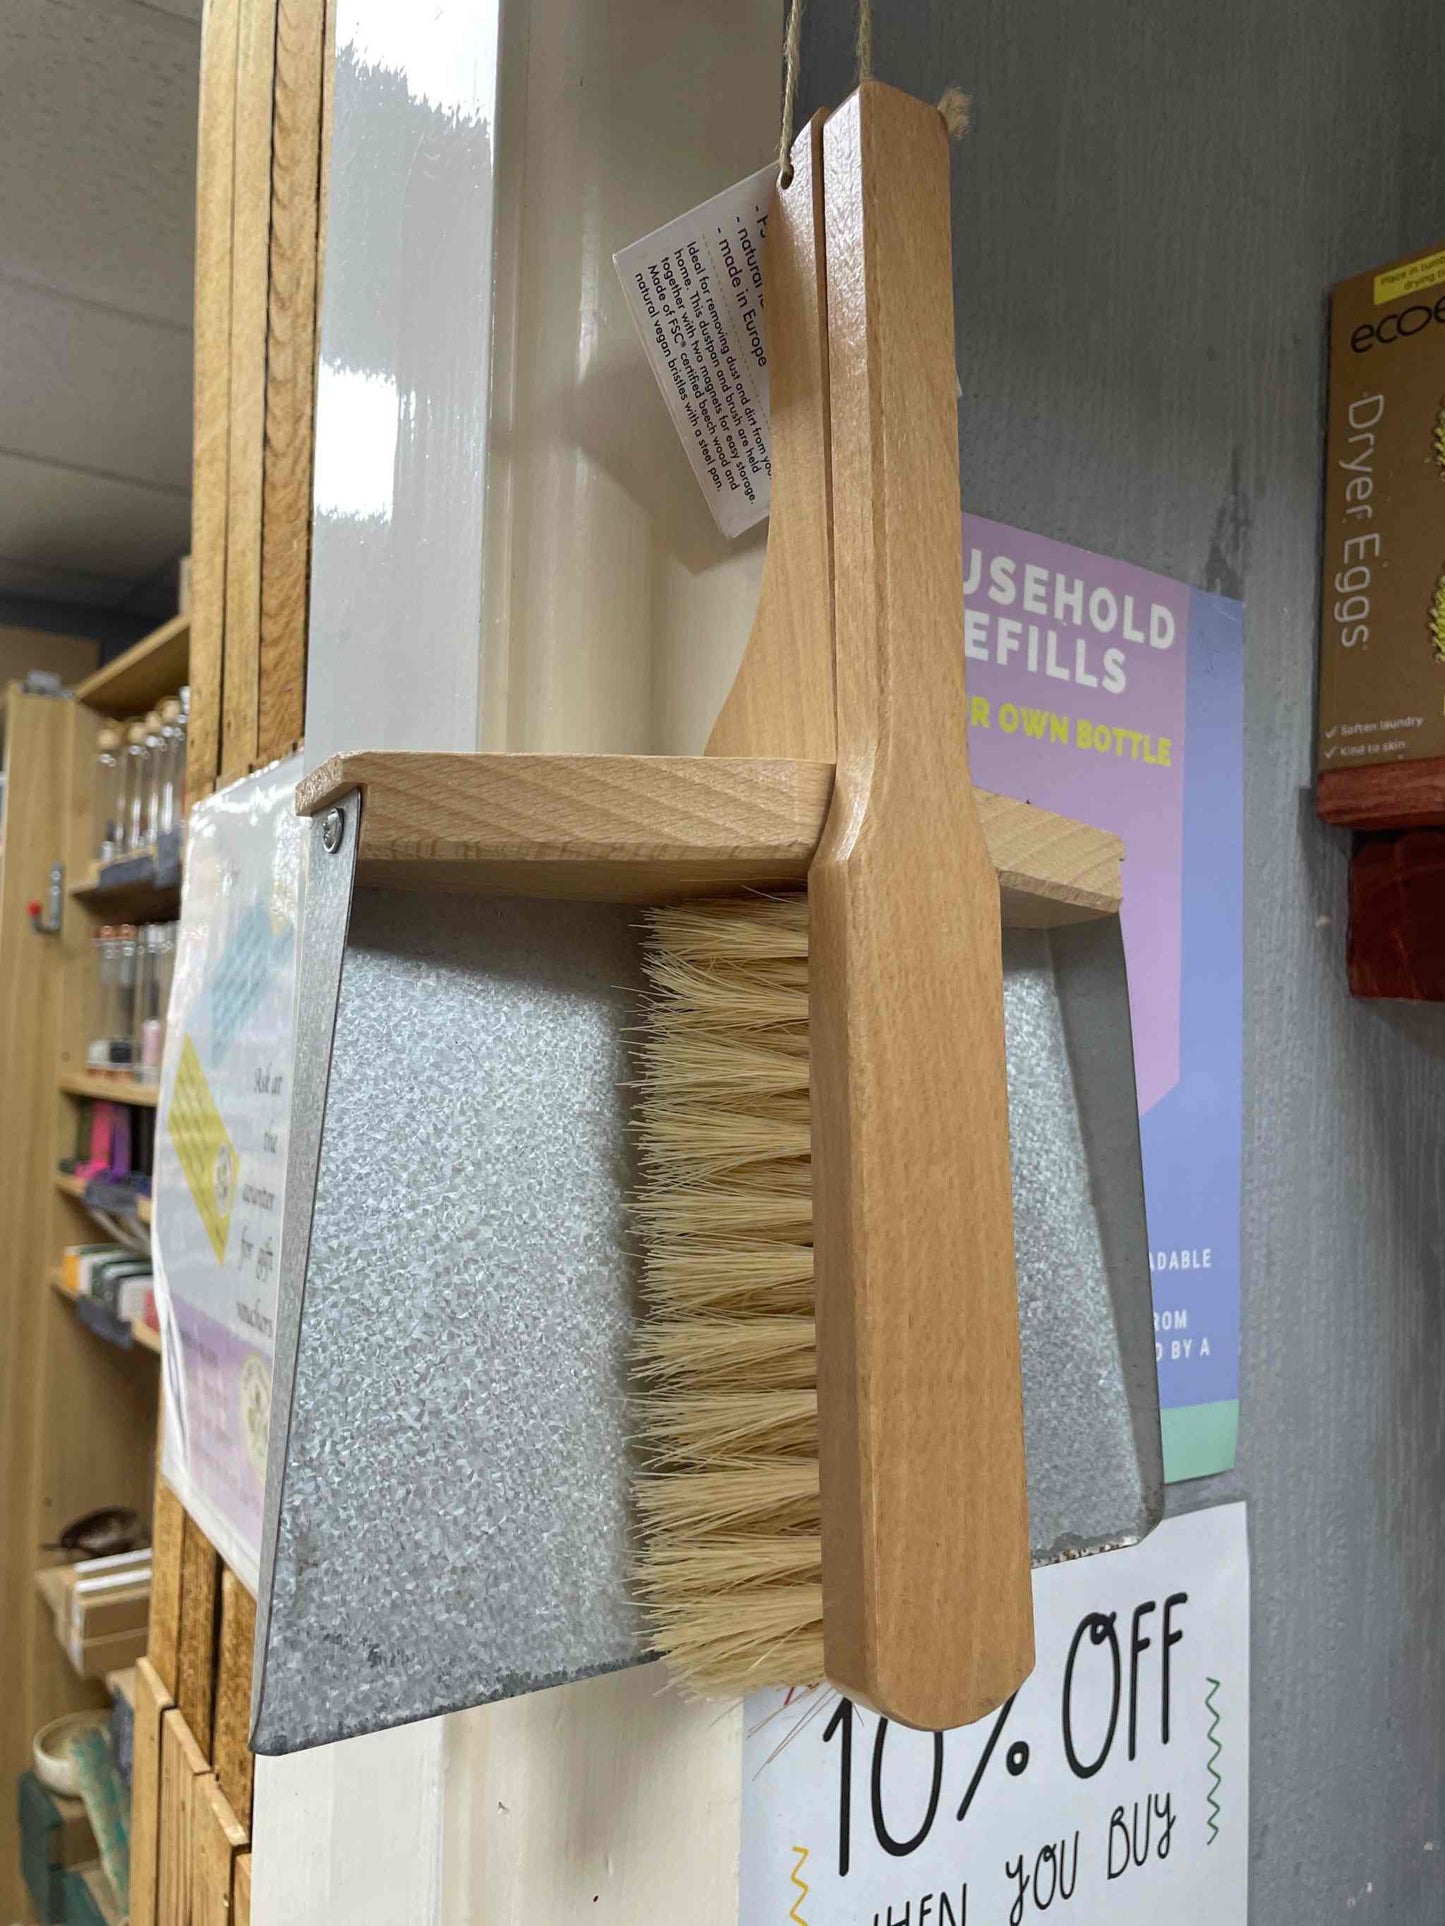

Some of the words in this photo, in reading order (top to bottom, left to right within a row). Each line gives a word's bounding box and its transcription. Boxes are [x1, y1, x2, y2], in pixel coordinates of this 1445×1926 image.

[686, 241, 706, 274] Ideal
[698, 275, 710, 294] for
[705, 297, 729, 354] removing
[719, 238, 743, 288] made
[736, 288, 749, 308] in
[743, 309, 767, 367] Europe
[634, 272, 660, 318] natural
[653, 318, 671, 357] vegan
[667, 357, 688, 400] bristles
[684, 401, 699, 427] with
[694, 428, 702, 438] a
[698, 438, 716, 465] steel
[707, 466, 723, 493] pan.
[647, 264, 667, 301] Made
[662, 304, 675, 316] of
[680, 352, 705, 399] certified
[698, 398, 717, 435] beech
[712, 435, 731, 467] wood
[724, 468, 740, 490] and
[660, 256, 685, 309] together
[681, 311, 696, 339] with
[690, 339, 703, 363] two
[699, 364, 722, 414] magnets
[718, 414, 729, 431] for
[725, 434, 739, 460] easy
[735, 461, 755, 504] storage.
[673, 247, 692, 292] home.
[689, 289, 703, 318] This
[698, 320, 719, 368] dustpan
[716, 369, 732, 392] and
[725, 392, 743, 426] brush
[737, 428, 749, 447] are
[745, 446, 762, 473] held
[726, 355, 740, 380] dust
[735, 382, 750, 405] and
[744, 407, 757, 426] dirt
[751, 426, 766, 454] from
[758, 455, 772, 480] you
[1339, 394, 1385, 519] Dryer
[1334, 533, 1380, 648] Eggs
[964, 609, 1127, 694] EFILLS
[966, 696, 991, 728] R
[999, 702, 1069, 745] OWN
[1076, 719, 1172, 767] BOTTLE
[1341, 723, 1378, 736] Soften
[1380, 716, 1424, 731] laundry
[1171, 1338, 1193, 1360] BY
[1200, 1337, 1210, 1357] A
[822, 1692, 1030, 1876] 10%
[1063, 1592, 1188, 1780] OFF
[1107, 1792, 1176, 1881] BUY
